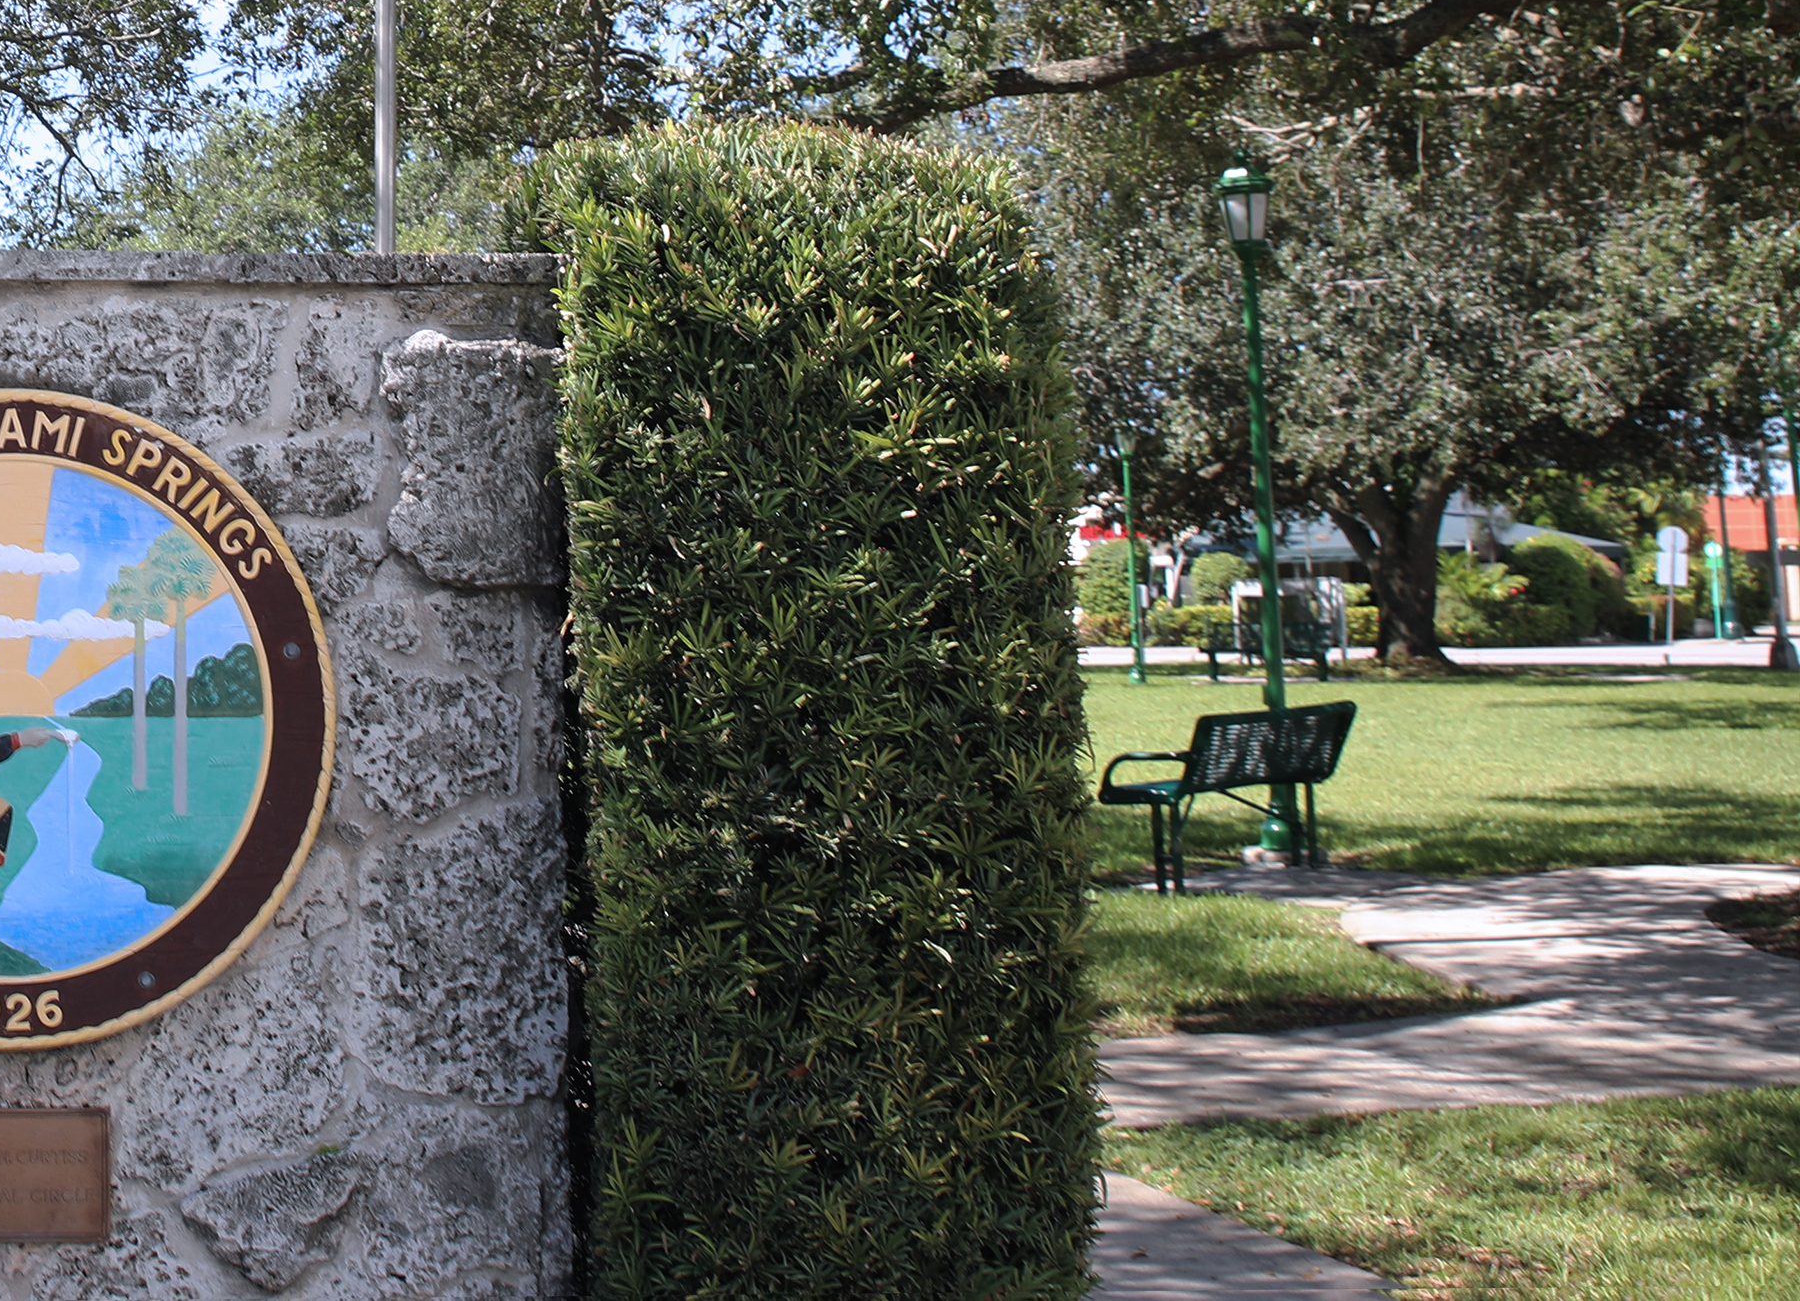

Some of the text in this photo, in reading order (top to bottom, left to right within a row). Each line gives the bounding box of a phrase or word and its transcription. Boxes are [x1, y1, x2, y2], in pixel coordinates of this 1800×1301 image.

[102, 429, 272, 580] SPRINGS
[16, 1148, 89, 1165] CURTISS
[29, 1187, 98, 1204] CIRCLE
